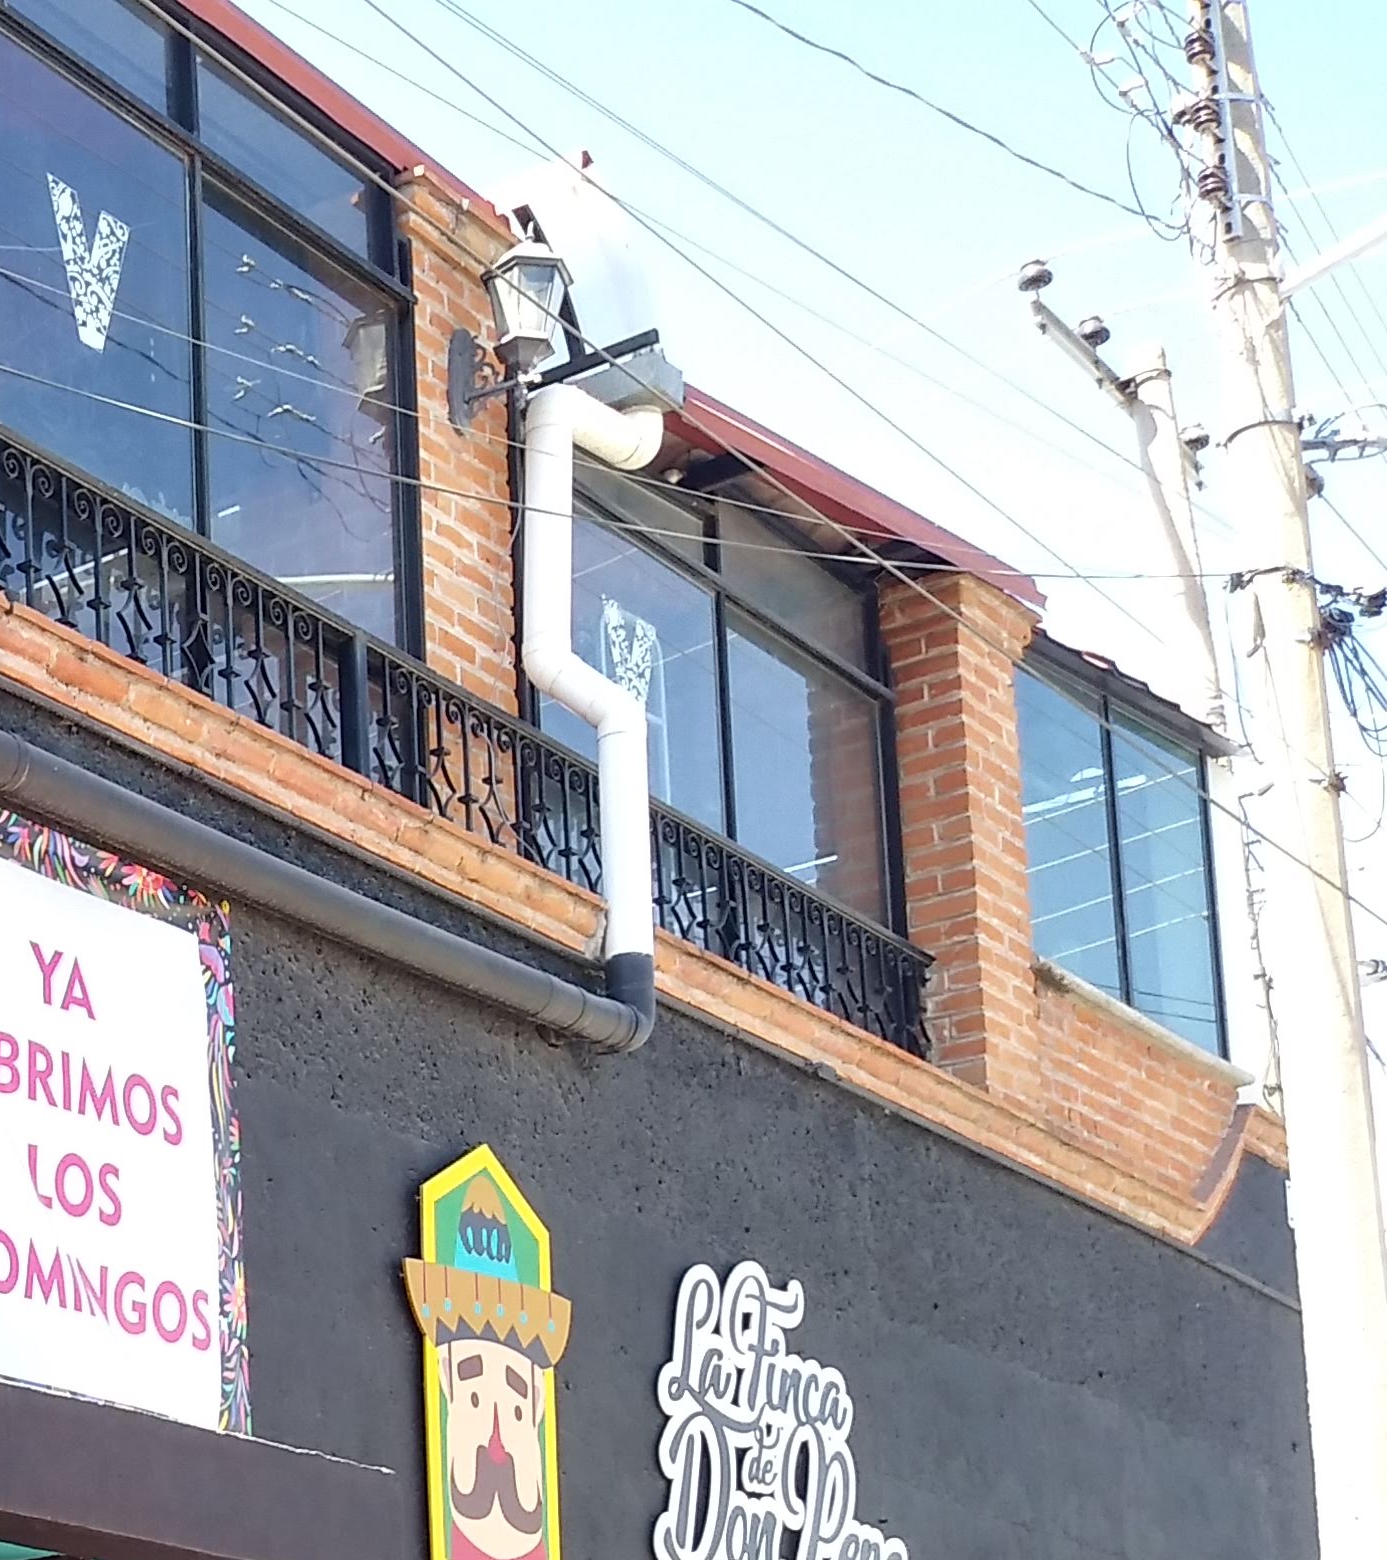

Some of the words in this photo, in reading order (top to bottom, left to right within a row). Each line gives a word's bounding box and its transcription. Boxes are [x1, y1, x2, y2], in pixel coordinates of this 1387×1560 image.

[29, 940, 96, 1020] YA
[27, 1143, 122, 1227] LOS
[664, 1273, 747, 1415] La
[727, 1270, 852, 1430] Finca
[747, 1428, 783, 1486] de
